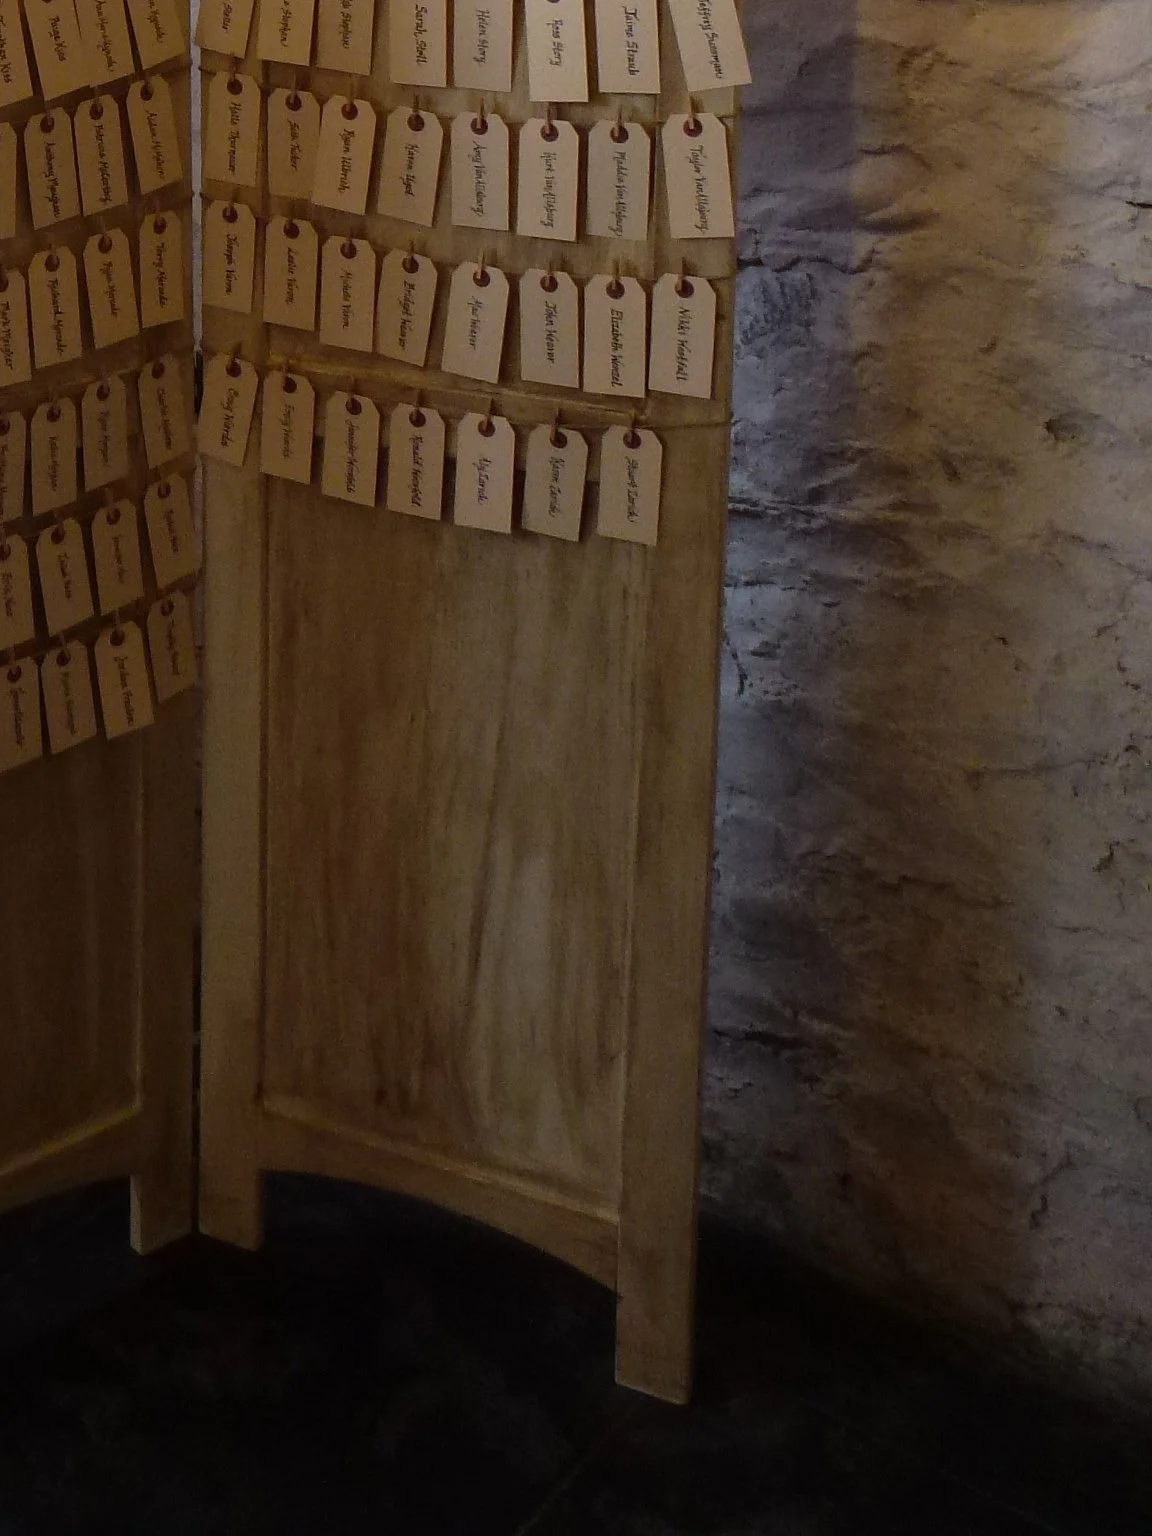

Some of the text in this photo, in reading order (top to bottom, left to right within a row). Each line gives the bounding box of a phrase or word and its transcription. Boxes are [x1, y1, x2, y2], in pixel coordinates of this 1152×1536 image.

[413, 3, 428, 39] Sarah
[476, 9, 491, 37] Helen
[544, 300, 558, 327] John
